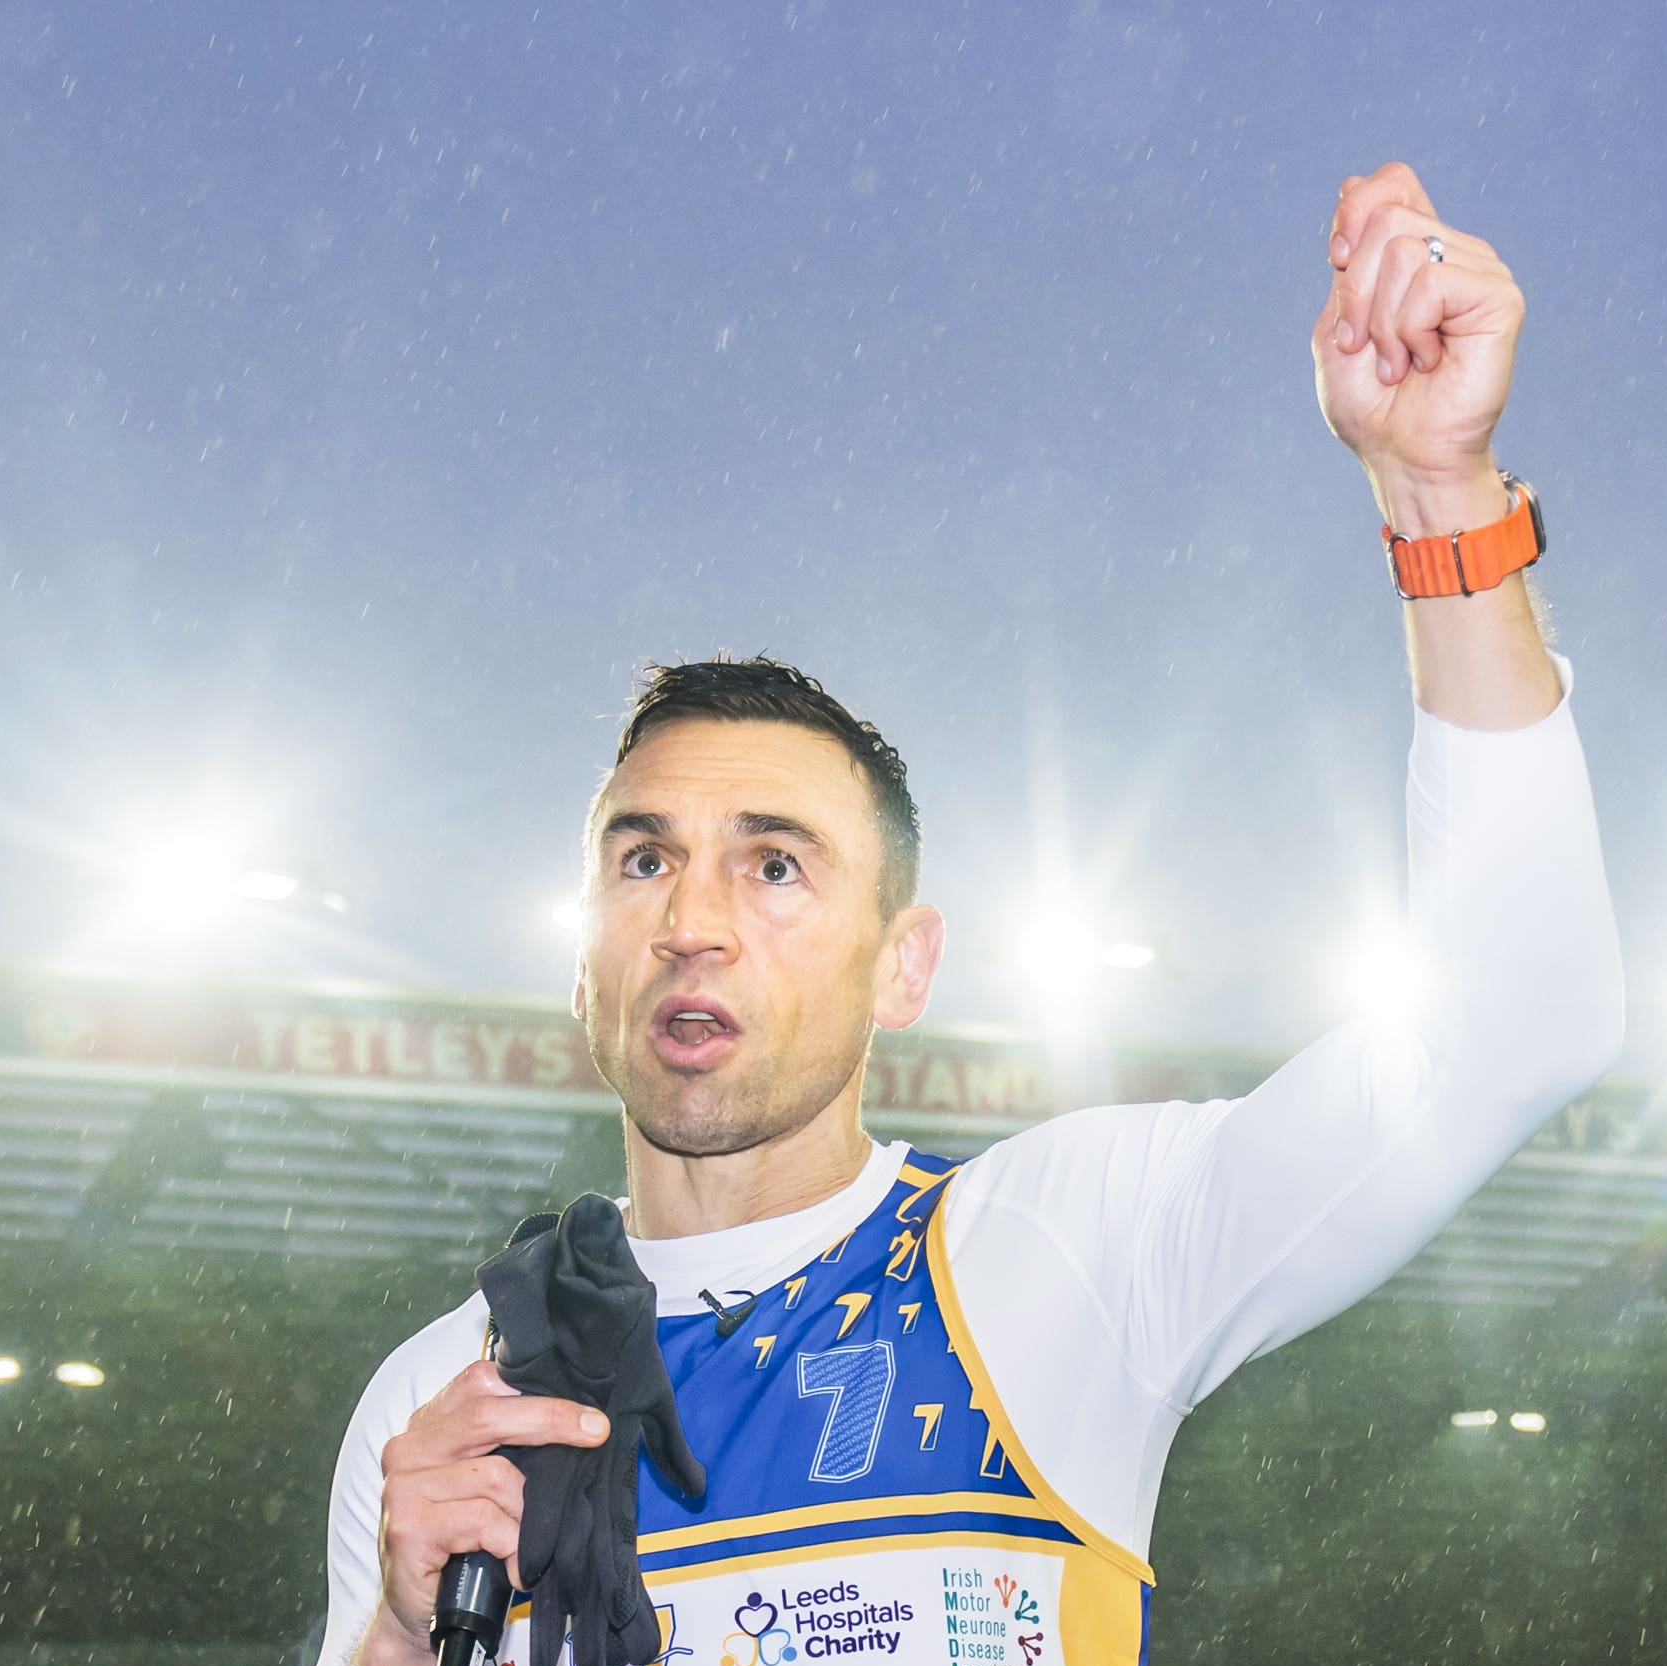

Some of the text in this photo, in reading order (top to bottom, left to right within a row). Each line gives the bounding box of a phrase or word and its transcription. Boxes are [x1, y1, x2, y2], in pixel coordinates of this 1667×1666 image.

[253, 1015, 576, 1084] TETLEY'S
[797, 1339, 896, 1483] 7
[942, 1567, 983, 1588] Irish
[781, 1580, 860, 1610] Leeds
[944, 1591, 991, 1612] Motor
[795, 1600, 914, 1634] Hospitals
[946, 1614, 1006, 1638] Neurone
[805, 1627, 901, 1659] Charity
[948, 1638, 1005, 1661] Disease
